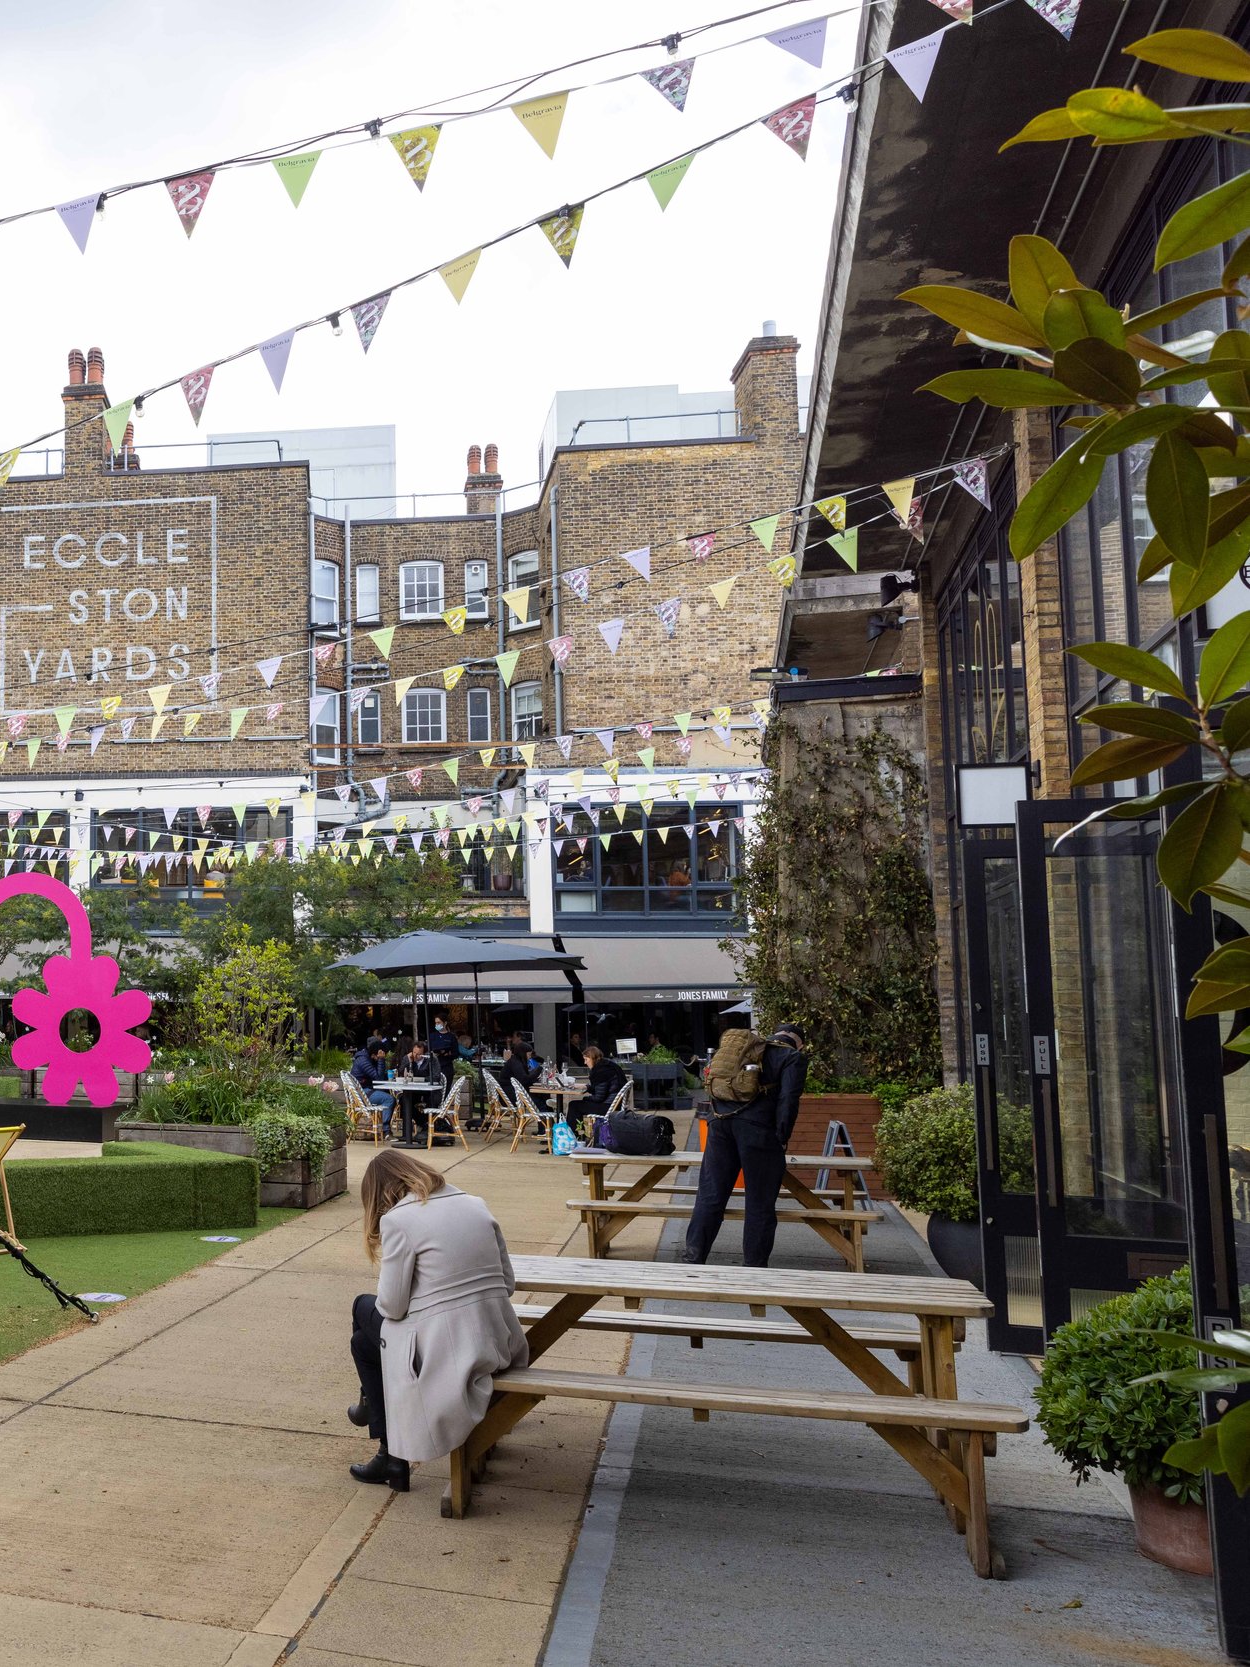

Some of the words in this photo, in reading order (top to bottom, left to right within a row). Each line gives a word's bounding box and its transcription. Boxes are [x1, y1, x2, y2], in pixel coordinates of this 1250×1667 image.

[778, 29, 822, 45] Belgravia
[893, 41, 937, 58] Belgravia
[522, 105, 562, 119] Belgravia
[278, 157, 315, 167] Belgravia
[651, 163, 687, 178] Belgravia
[60, 198, 94, 213] Belgravia
[262, 338, 290, 351] Belgravia
[23, 528, 188, 569] ECCLE
[68, 586, 188, 625] STON
[23, 643, 190, 684] YARDS
[677, 991, 701, 1000] JONES
[702, 991, 728, 1000] FAMILY
[1039, 1040, 1047, 1069] PULL
